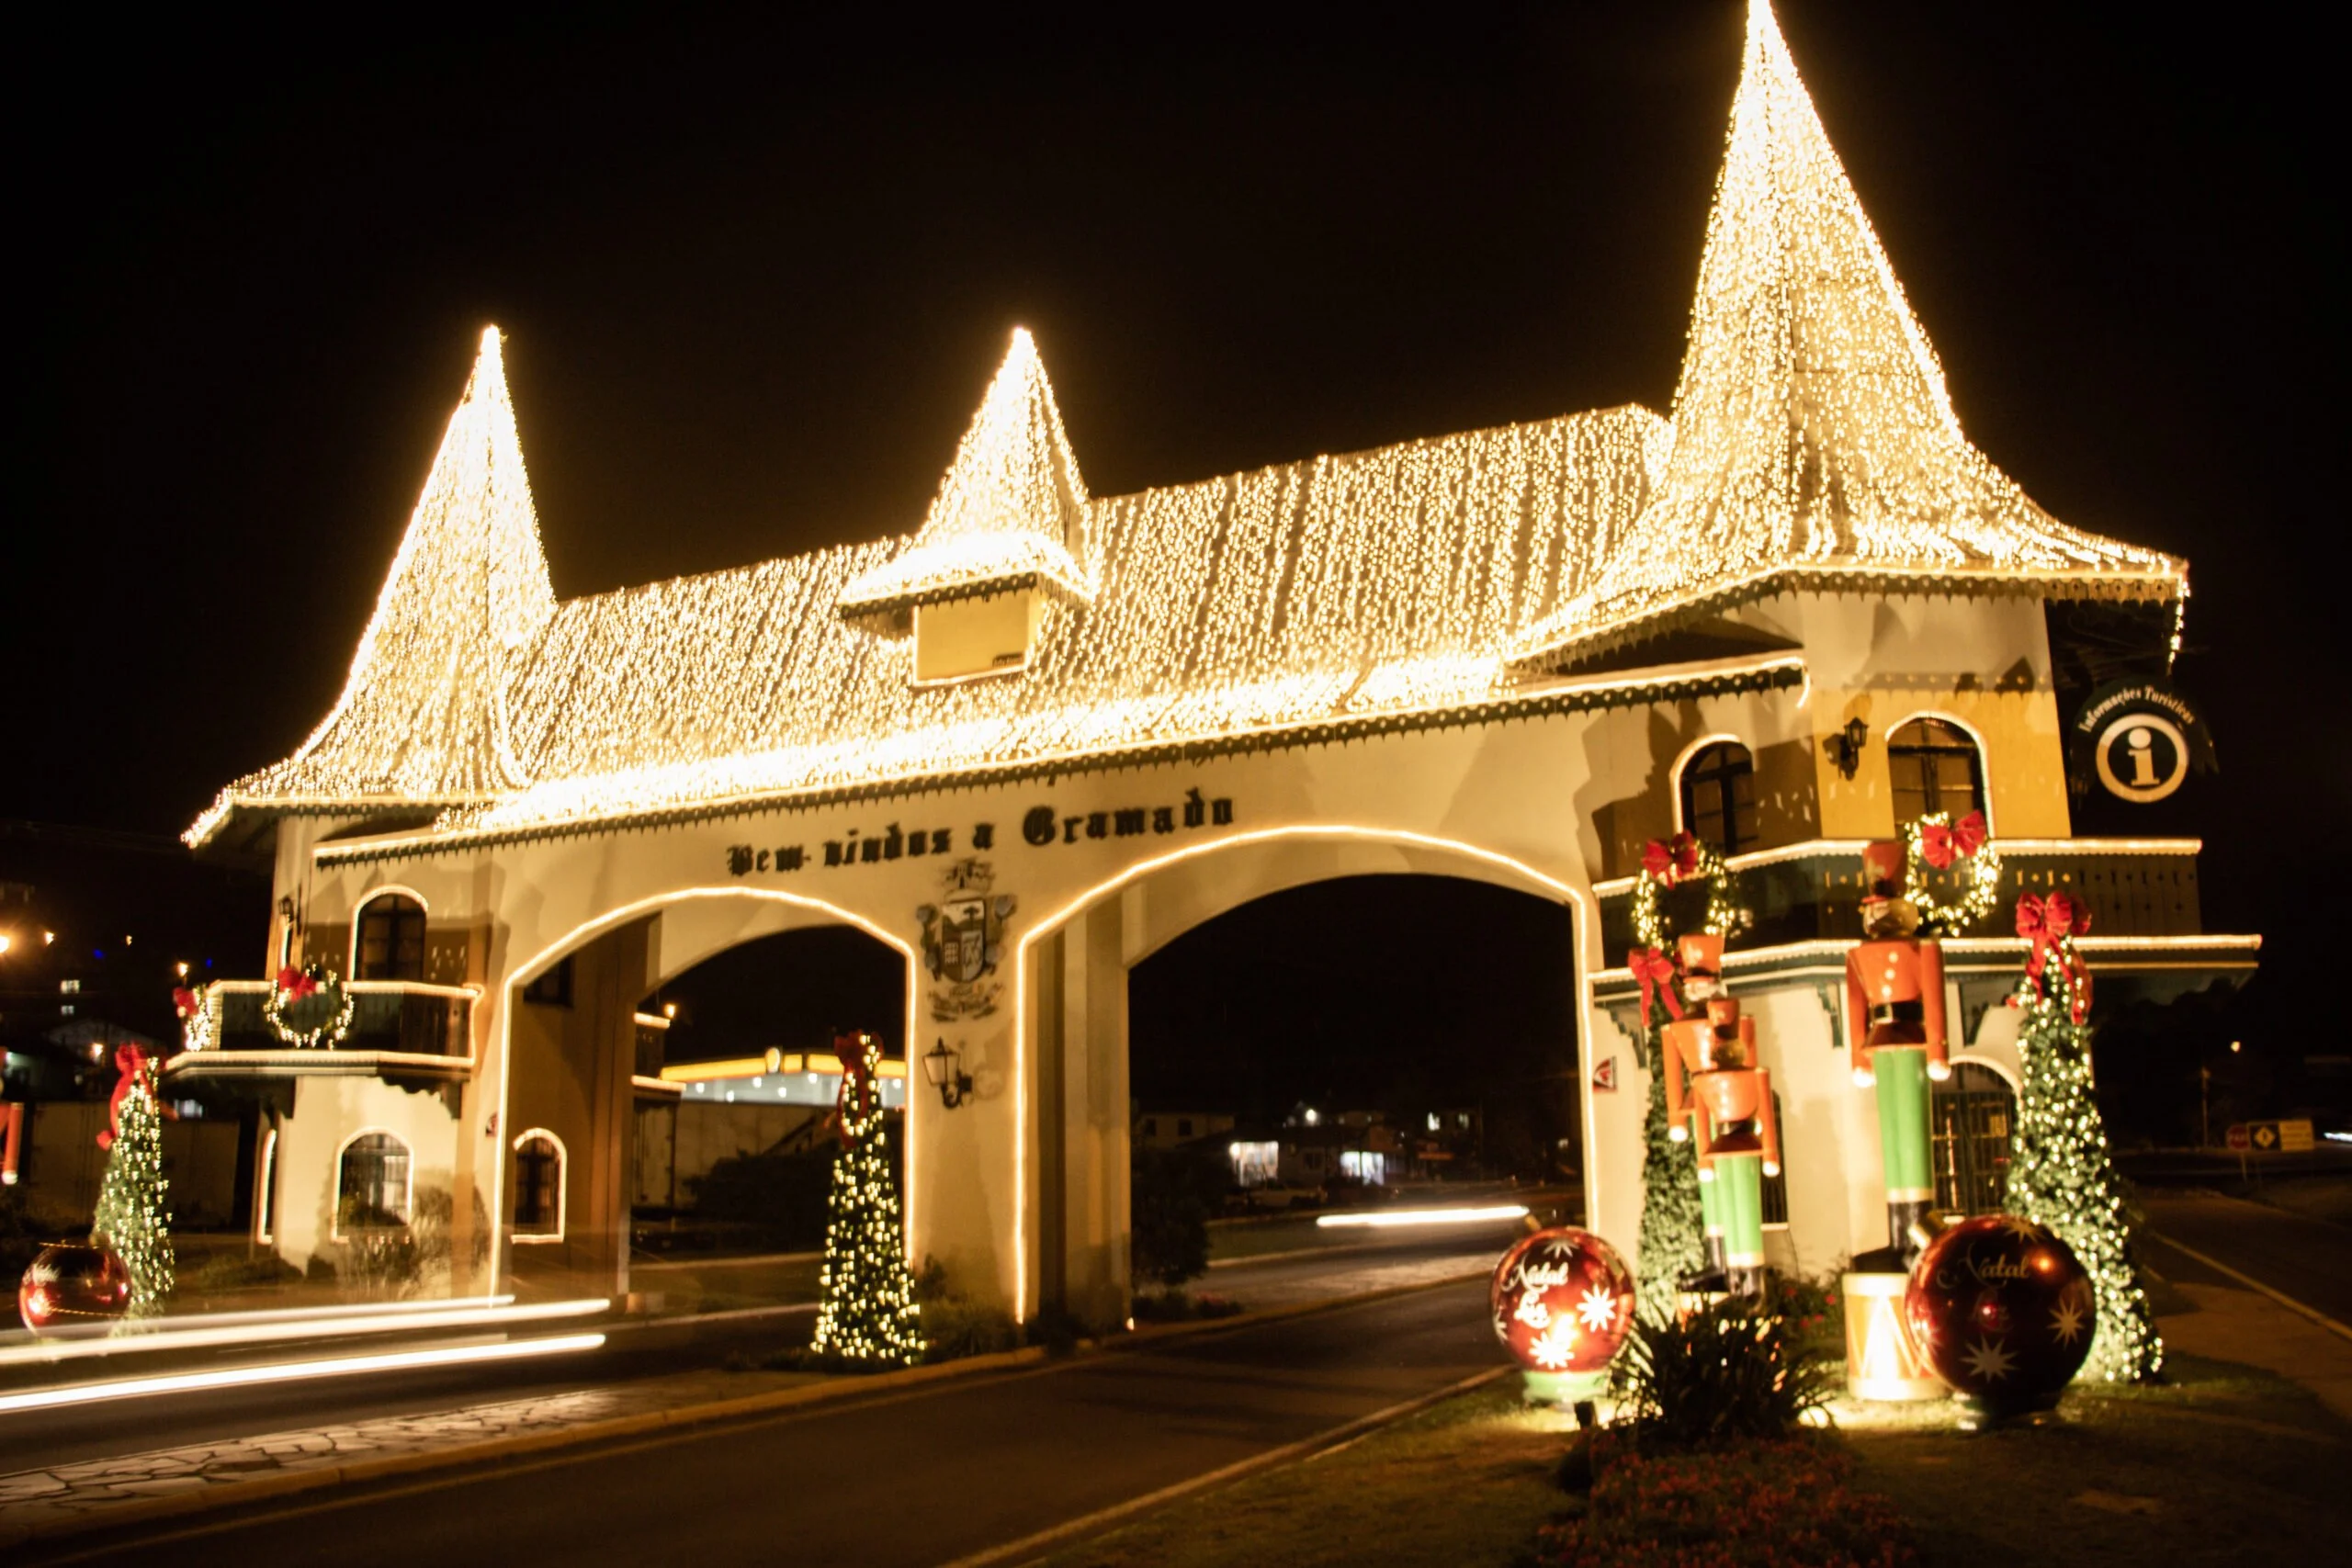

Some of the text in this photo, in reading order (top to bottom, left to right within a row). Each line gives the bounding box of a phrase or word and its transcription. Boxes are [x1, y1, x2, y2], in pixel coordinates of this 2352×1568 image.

[971, 822, 994, 851] a
[1022, 786, 1235, 846] Gramado
[1501, 1255, 1569, 1293] Natal
[1937, 1241, 2030, 1288] Natal
